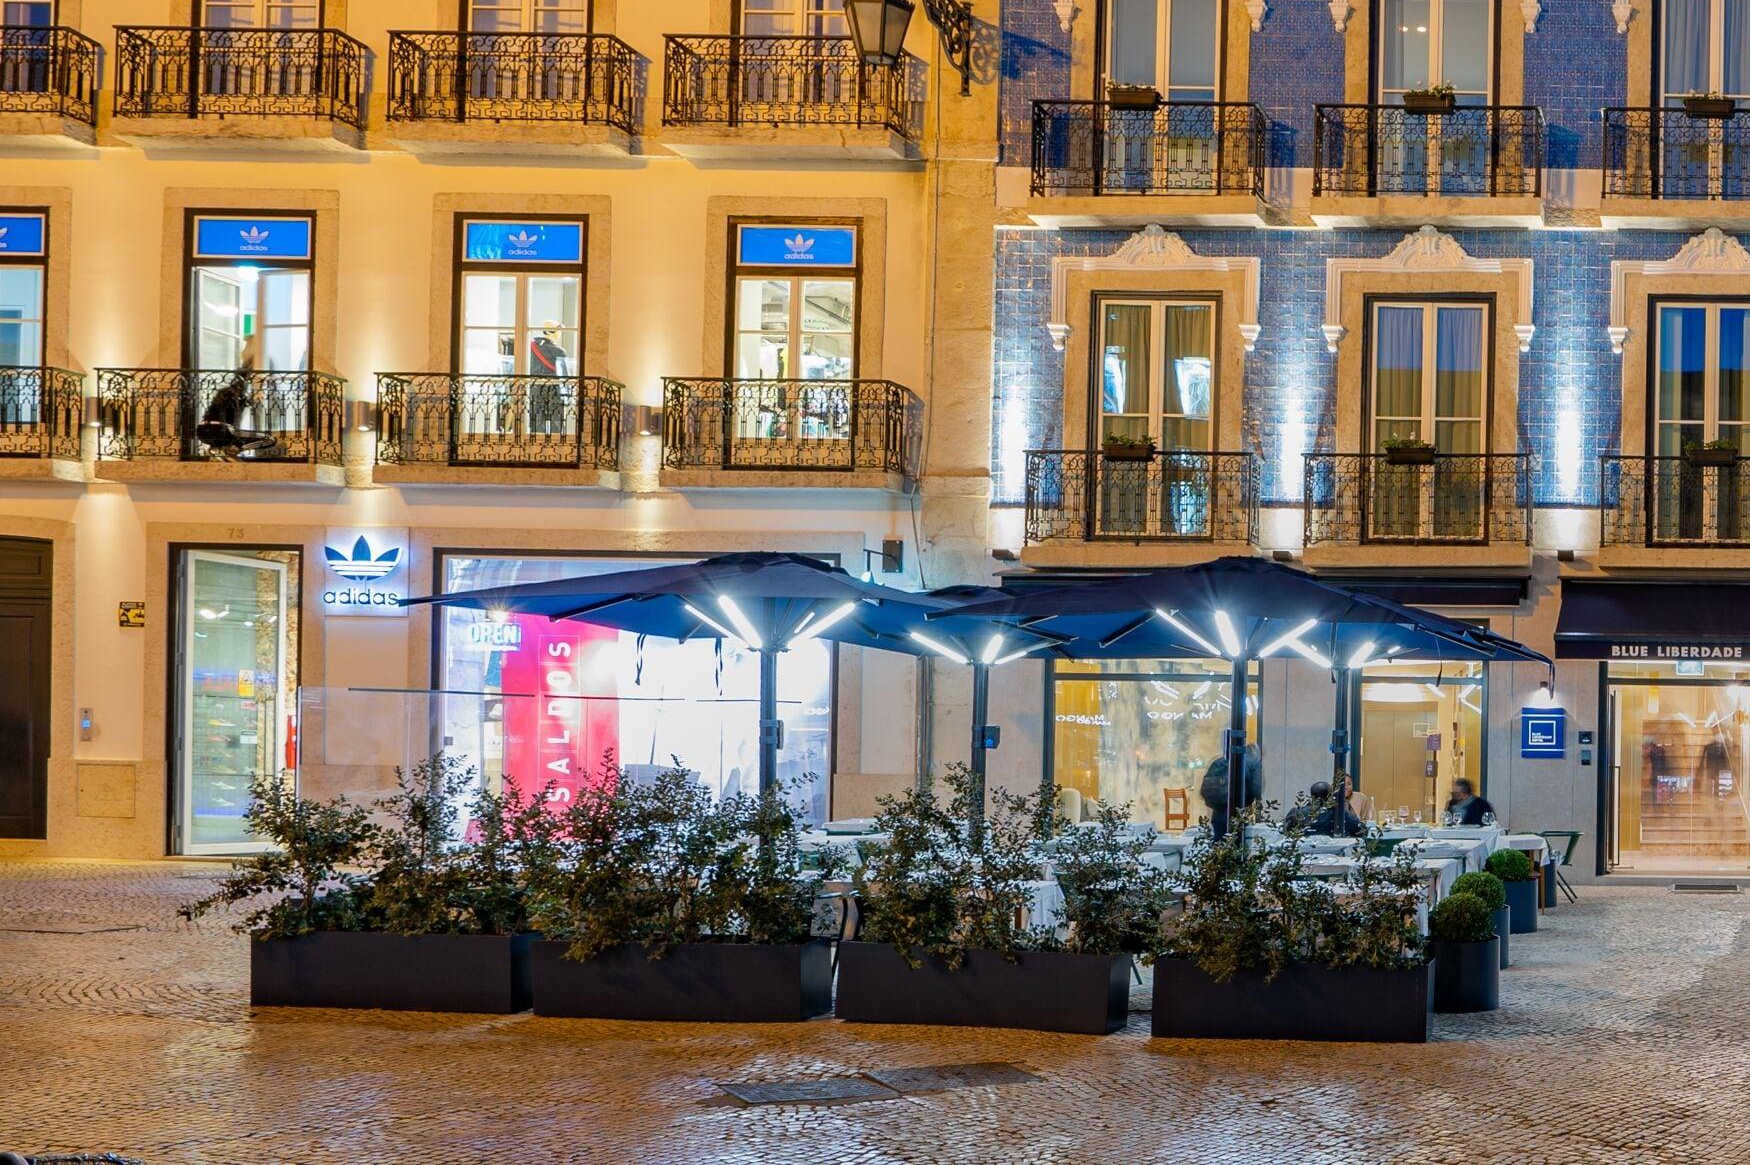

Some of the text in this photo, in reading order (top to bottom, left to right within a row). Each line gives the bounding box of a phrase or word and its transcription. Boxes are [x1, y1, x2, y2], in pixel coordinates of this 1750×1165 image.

[226, 527, 245, 539] 73
[323, 587, 400, 606] adidas
[469, 623, 520, 644] OPEN
[1611, 645, 1649, 657] BLUE
[1657, 646, 1742, 658] LIBERDADE
[546, 641, 573, 803] SALDOS
